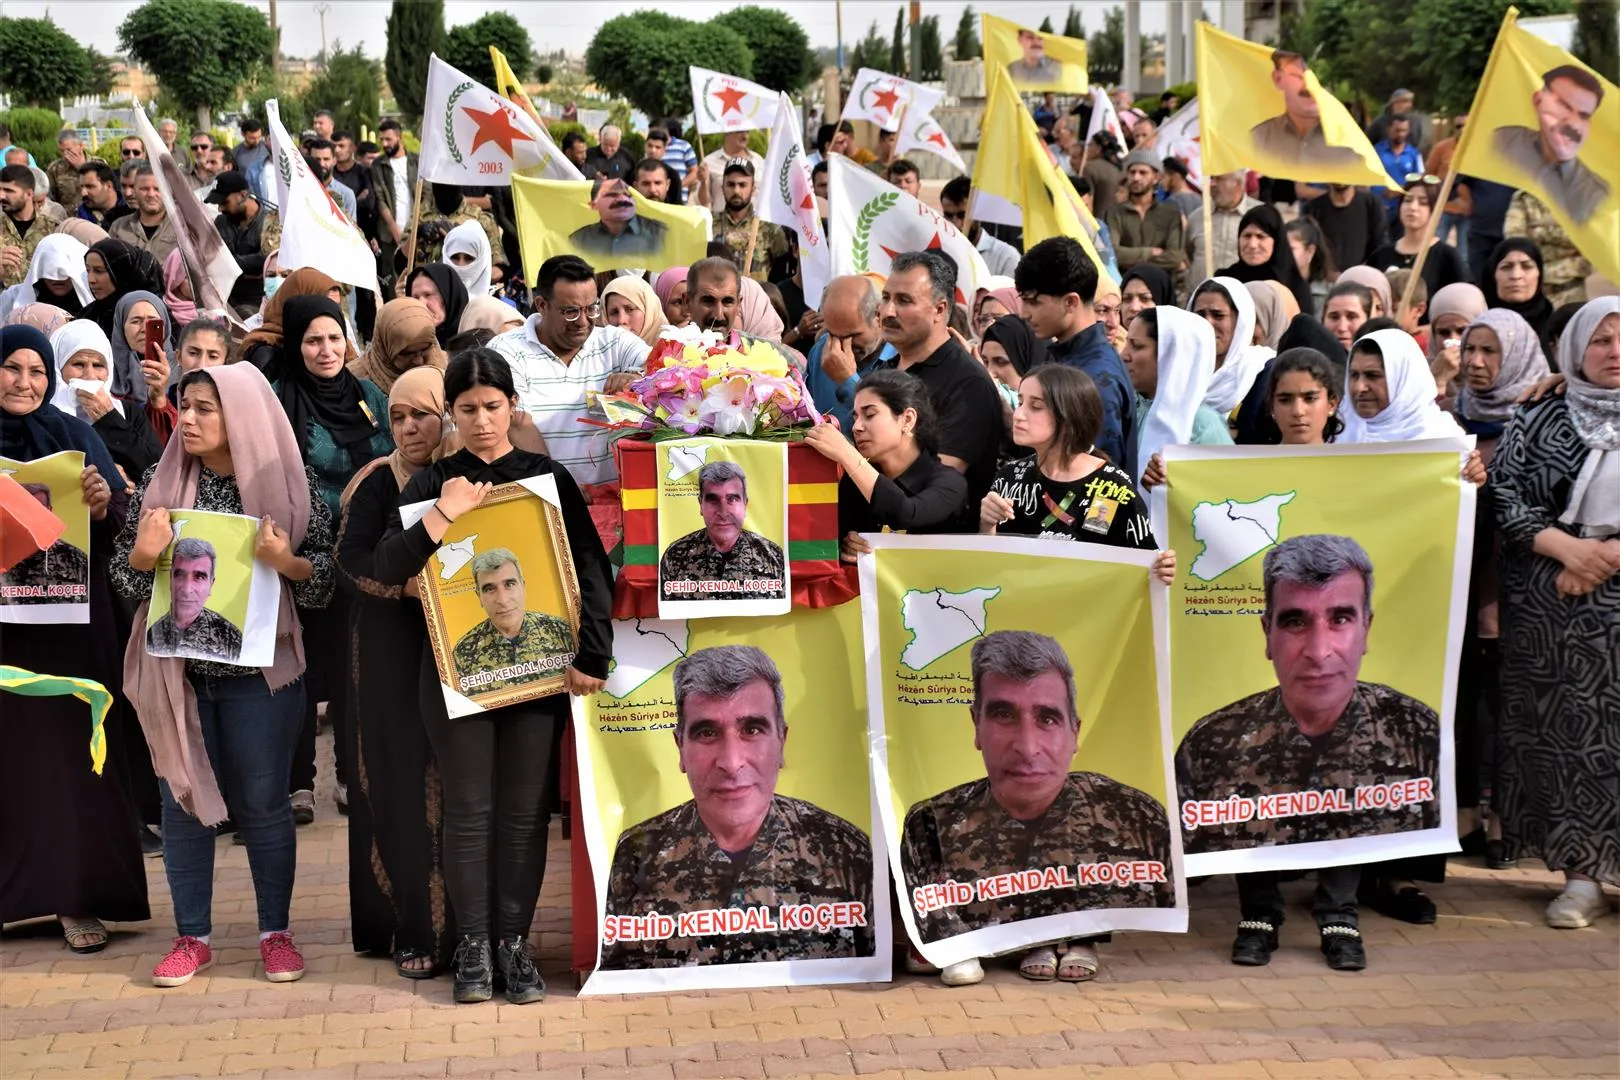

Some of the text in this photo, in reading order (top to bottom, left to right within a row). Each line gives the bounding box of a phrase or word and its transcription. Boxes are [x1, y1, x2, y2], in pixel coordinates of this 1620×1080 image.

[478, 162, 503, 174] 2003
[1085, 477, 1136, 505] HOME
[2, 585, 87, 598] KENDAL KOÇER
[665, 579, 783, 594] ŞEHÎD KENDAL KOÇER
[460, 653, 575, 691] ŞEHÎD KENDAL KOÇER
[1182, 779, 1435, 830] ŞEHÎD KENDAL KOÇER
[913, 861, 1167, 918] ŞEHÎD KENDAL KOÇER
[604, 901, 867, 944] ŞEHÎD KENDAL KOÇER
